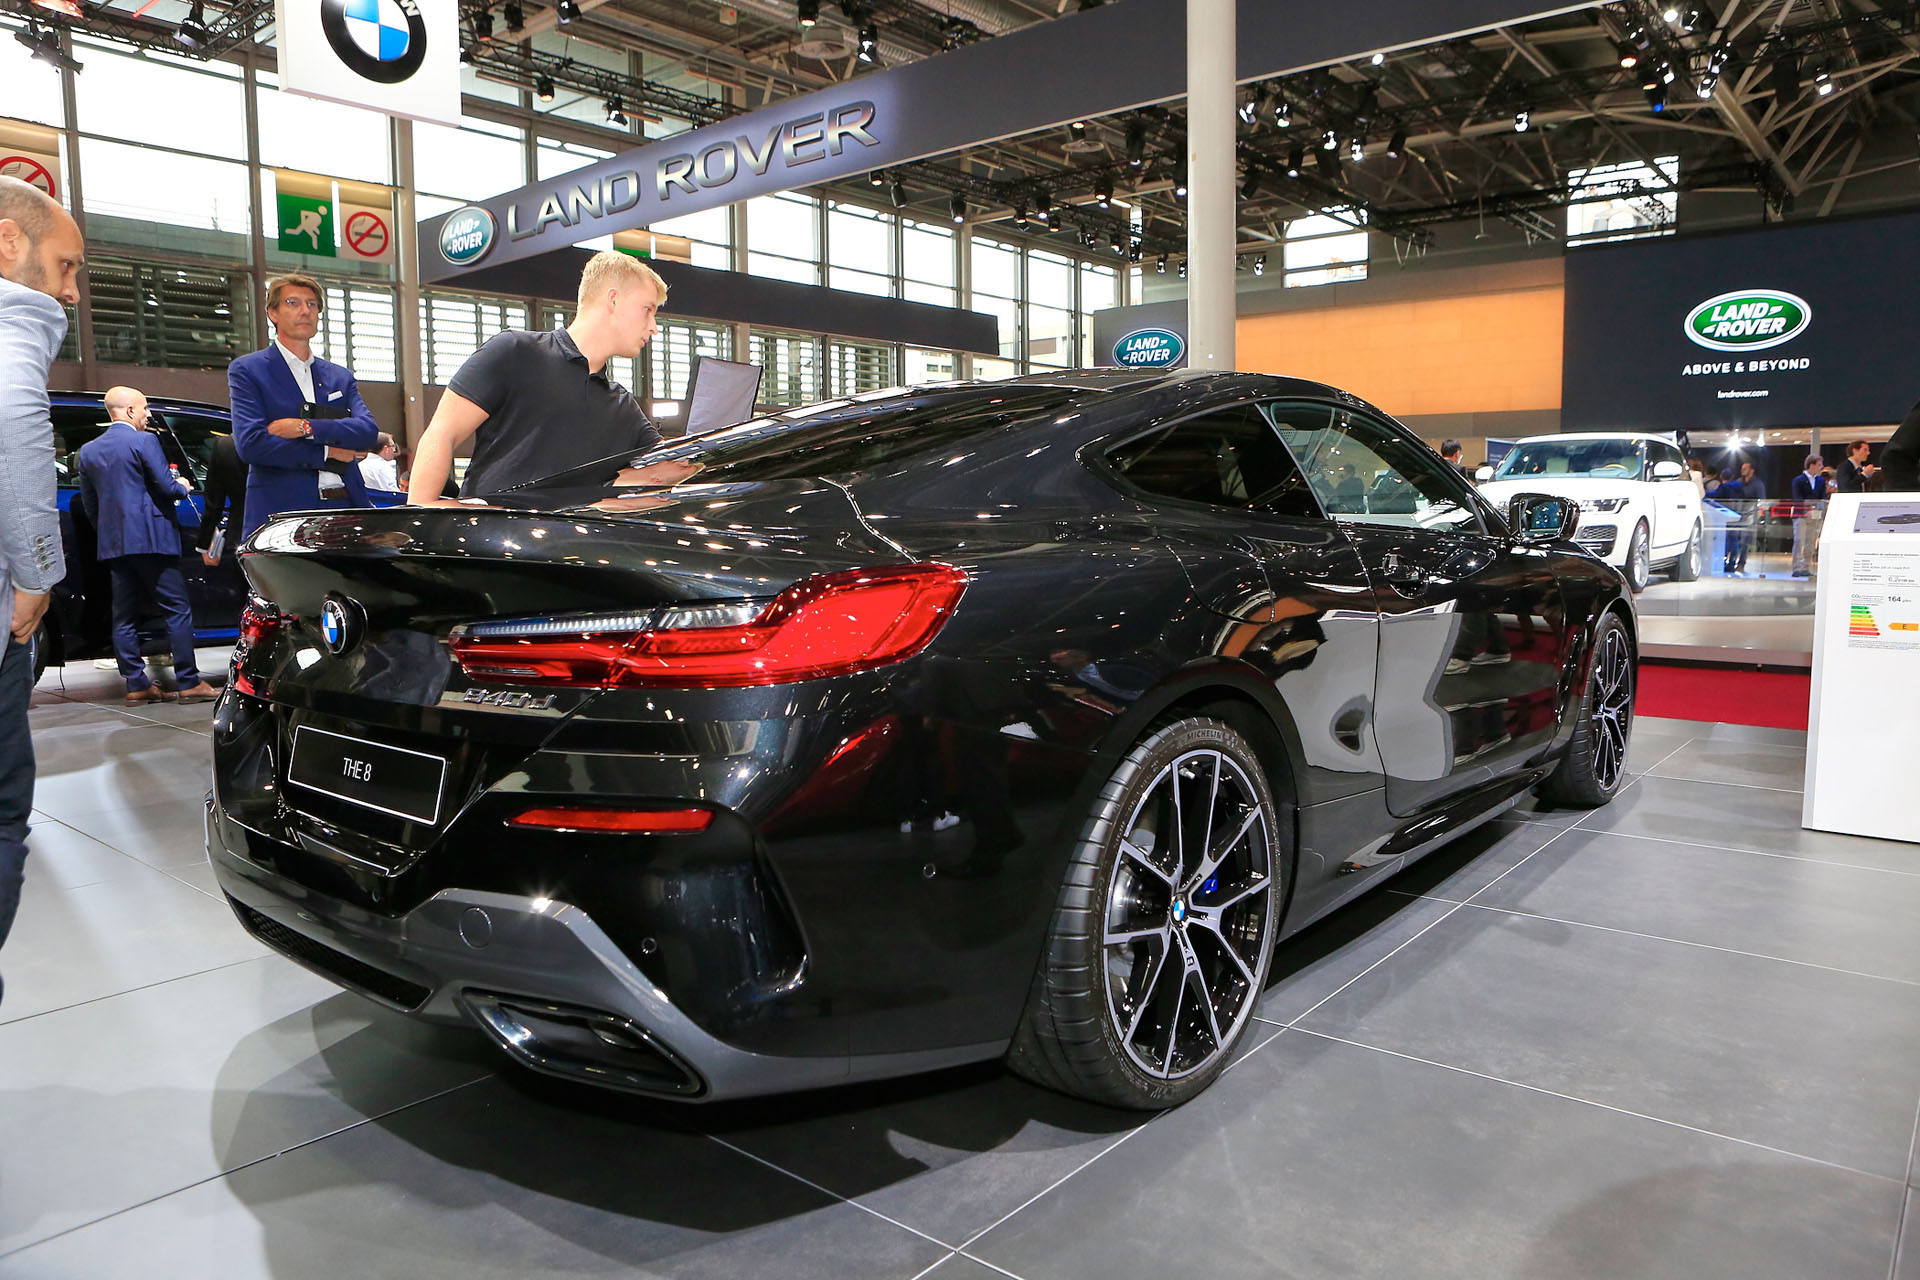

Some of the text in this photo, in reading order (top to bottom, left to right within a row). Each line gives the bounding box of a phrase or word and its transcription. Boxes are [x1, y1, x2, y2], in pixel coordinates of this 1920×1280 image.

[506, 100, 881, 242] LAND ROVER
[448, 218, 474, 239] LAND
[451, 232, 482, 254] ROVER
[1710, 302, 1770, 322] LAND
[1713, 317, 1787, 338] ROVER
[1126, 336, 1160, 351] LAND
[1129, 348, 1171, 364] ROVER
[1681, 357, 1810, 376] ABOVE & BEYOND
[1717, 389, 1769, 399] landrover.com
[1186, 729, 1224, 740] MICHELIN
[343, 757, 372, 782] THE 8
